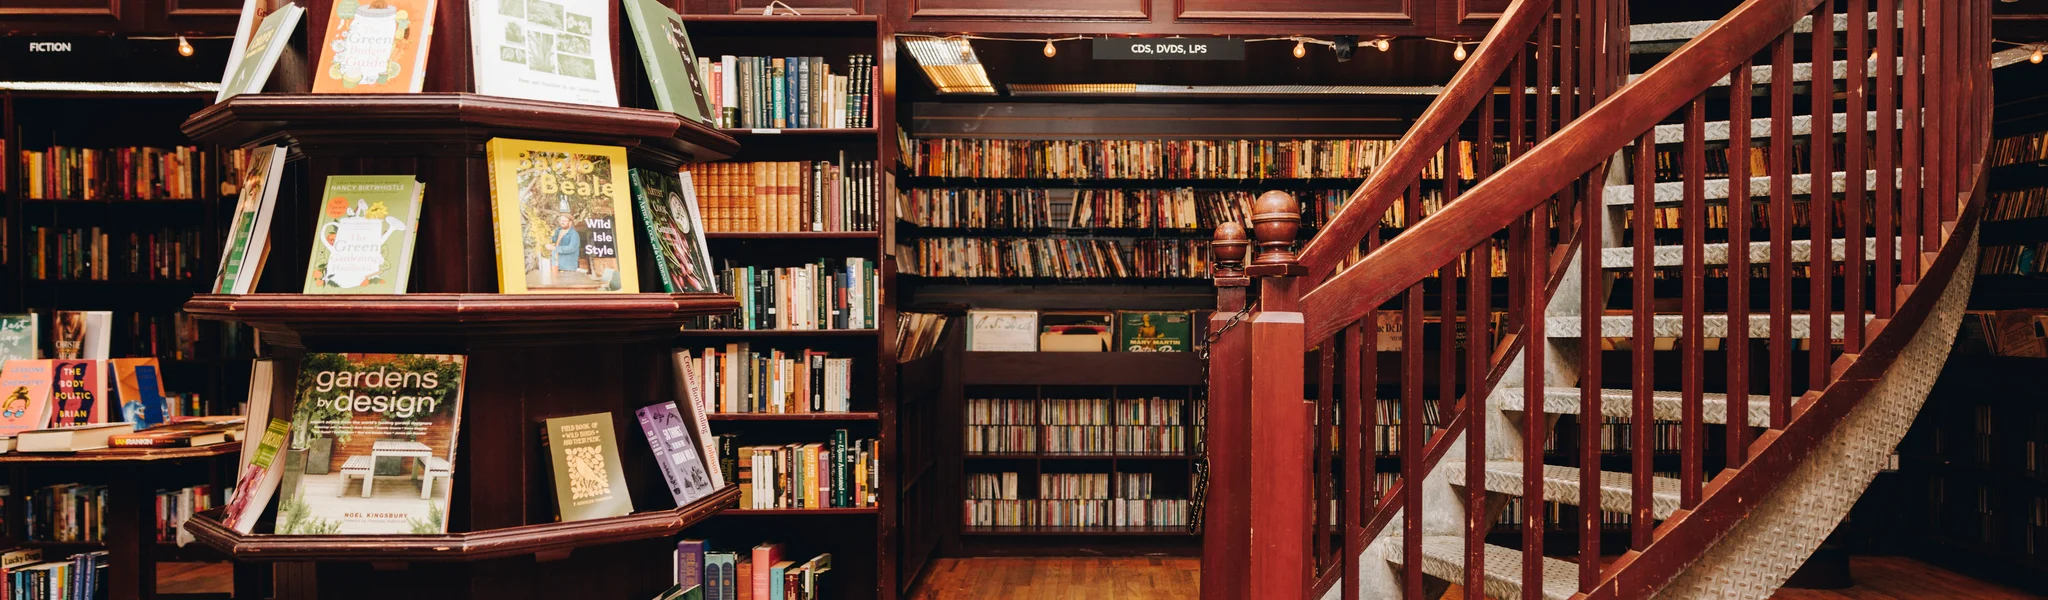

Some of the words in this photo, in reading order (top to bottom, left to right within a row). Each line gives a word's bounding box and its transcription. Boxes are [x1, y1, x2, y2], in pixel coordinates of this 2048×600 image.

[349, 32, 392, 44] Green
[29, 42, 71, 52] FICTION
[1131, 44, 1154, 54] CDS,
[1156, 44, 1186, 54] DVDS,
[1189, 44, 1207, 53] LPS
[346, 55, 385, 67] Guide
[519, 152, 594, 178] Banjo
[541, 174, 613, 196] Beale
[585, 218, 611, 229] Wild
[593, 232, 612, 242] Isle
[334, 240, 379, 252] Green
[585, 245, 613, 257] Style
[2, 318, 29, 331] Last
[64, 368, 81, 376] THE
[316, 366, 439, 392] gardens
[55, 392, 91, 400] POLITIC
[317, 397, 332, 409] by
[334, 390, 435, 418] design
[59, 410, 87, 418] BRIAN
[684, 355, 695, 385] Creative
[692, 386, 708, 435] Bookbinding
[706, 444, 719, 474] Johnson
[561, 424, 575, 432] FIELD
[4, 555, 23, 566] Lucky
